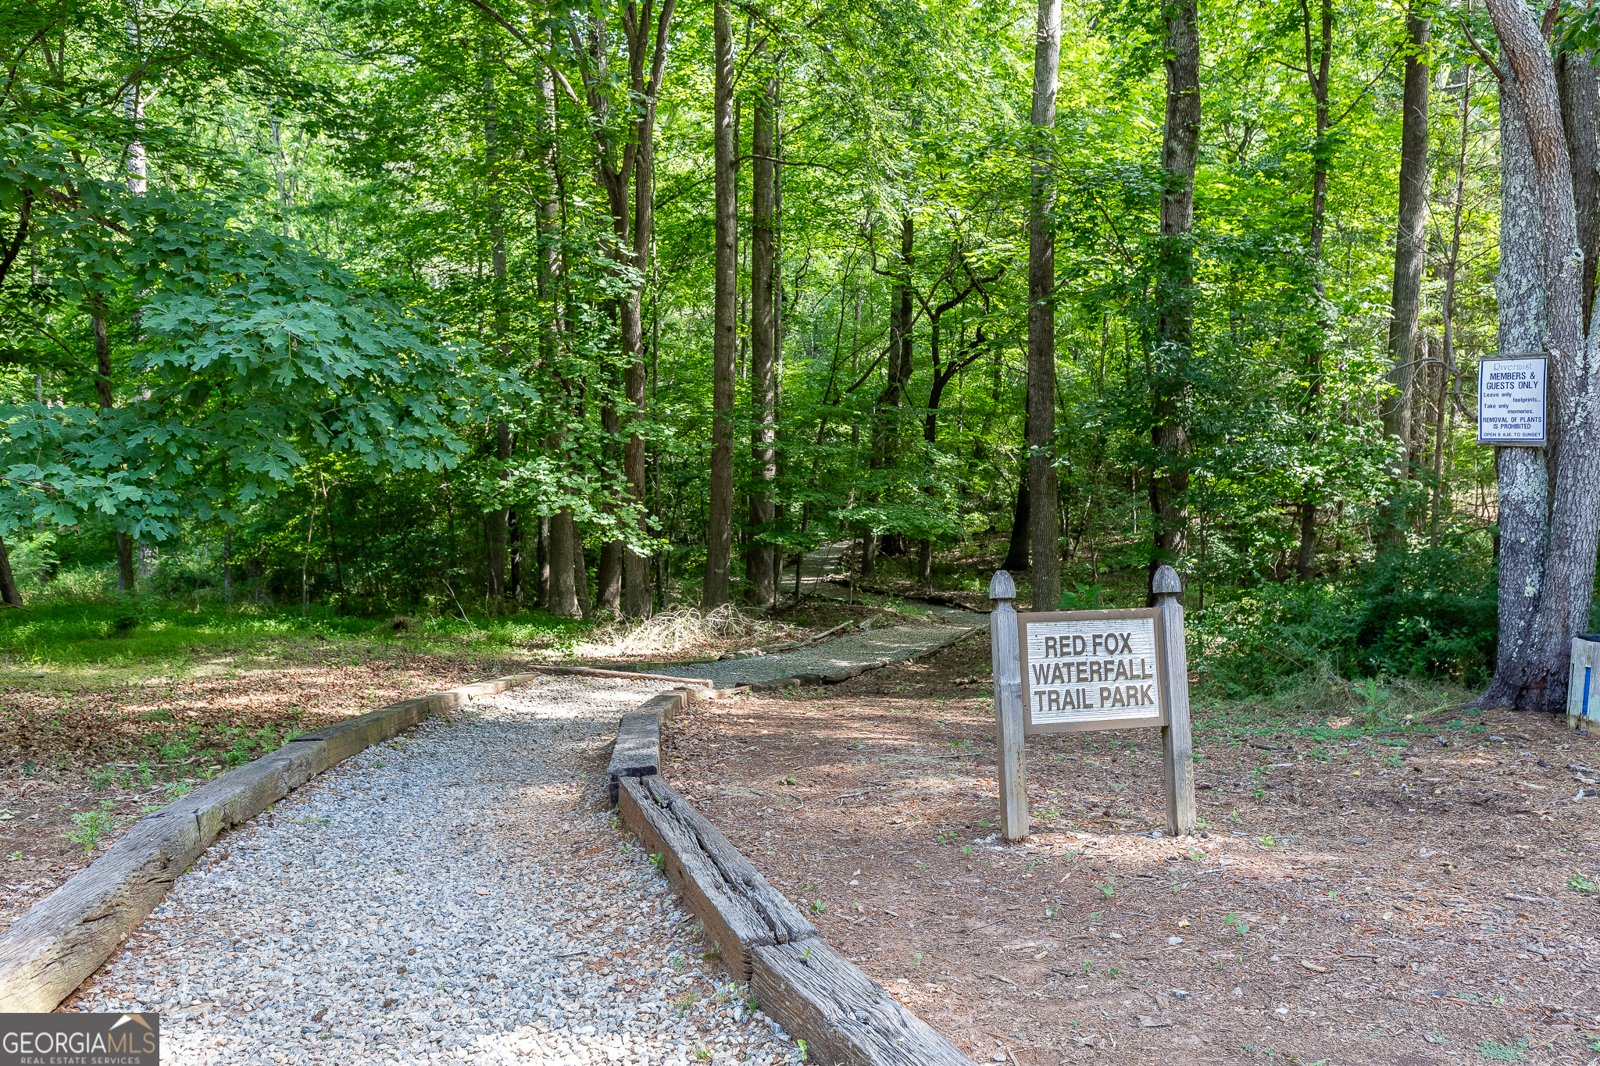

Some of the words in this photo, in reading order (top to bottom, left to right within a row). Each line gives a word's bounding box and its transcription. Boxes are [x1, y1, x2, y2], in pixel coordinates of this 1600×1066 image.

[1486, 381, 1515, 390] GUESTS
[1518, 381, 1539, 389] ONLY
[1490, 372, 1526, 381] MEMBERS
[1530, 371, 1536, 380] &
[1044, 635, 1086, 658] RED
[1092, 632, 1133, 656] FOX
[1032, 658, 1153, 685] WATERFALL
[1034, 688, 1093, 712] TRAIL
[1099, 684, 1154, 708] PARK
